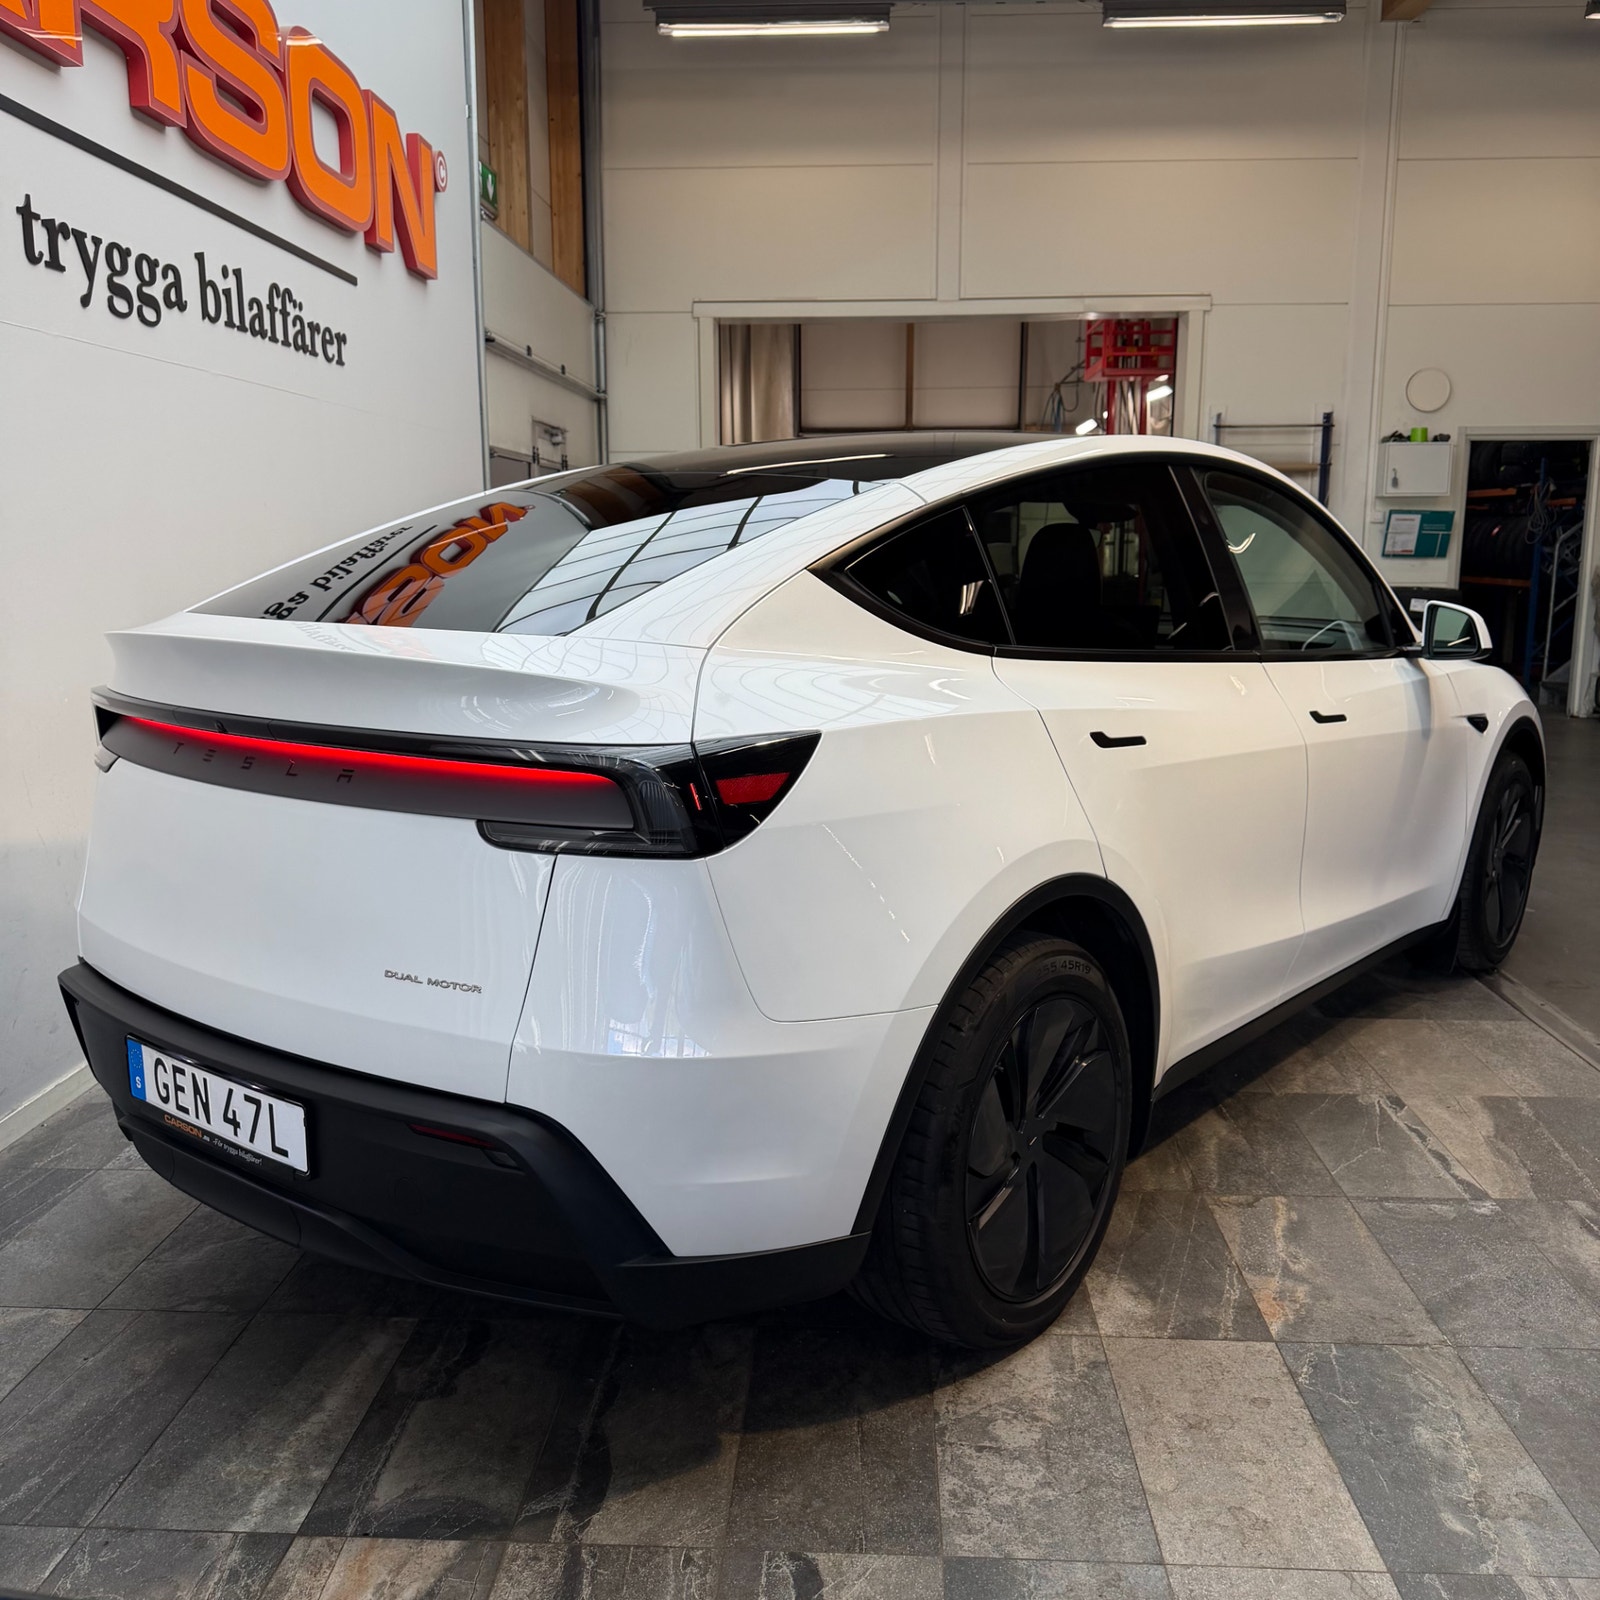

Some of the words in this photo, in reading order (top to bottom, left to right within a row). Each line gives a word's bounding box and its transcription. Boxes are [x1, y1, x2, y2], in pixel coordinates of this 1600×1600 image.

[0, 0, 437, 281] RSON
[16, 193, 188, 327] trygga
[194, 251, 347, 367] bilaffärer
[173, 741, 355, 784] TESLA
[384, 969, 424, 985] DUAL
[426, 977, 482, 994] MOTOR
[135, 1075, 143, 1089] S
[154, 1056, 212, 1126] GEN
[222, 1087, 290, 1159] 47L
[164, 1114, 203, 1139] CARSON
